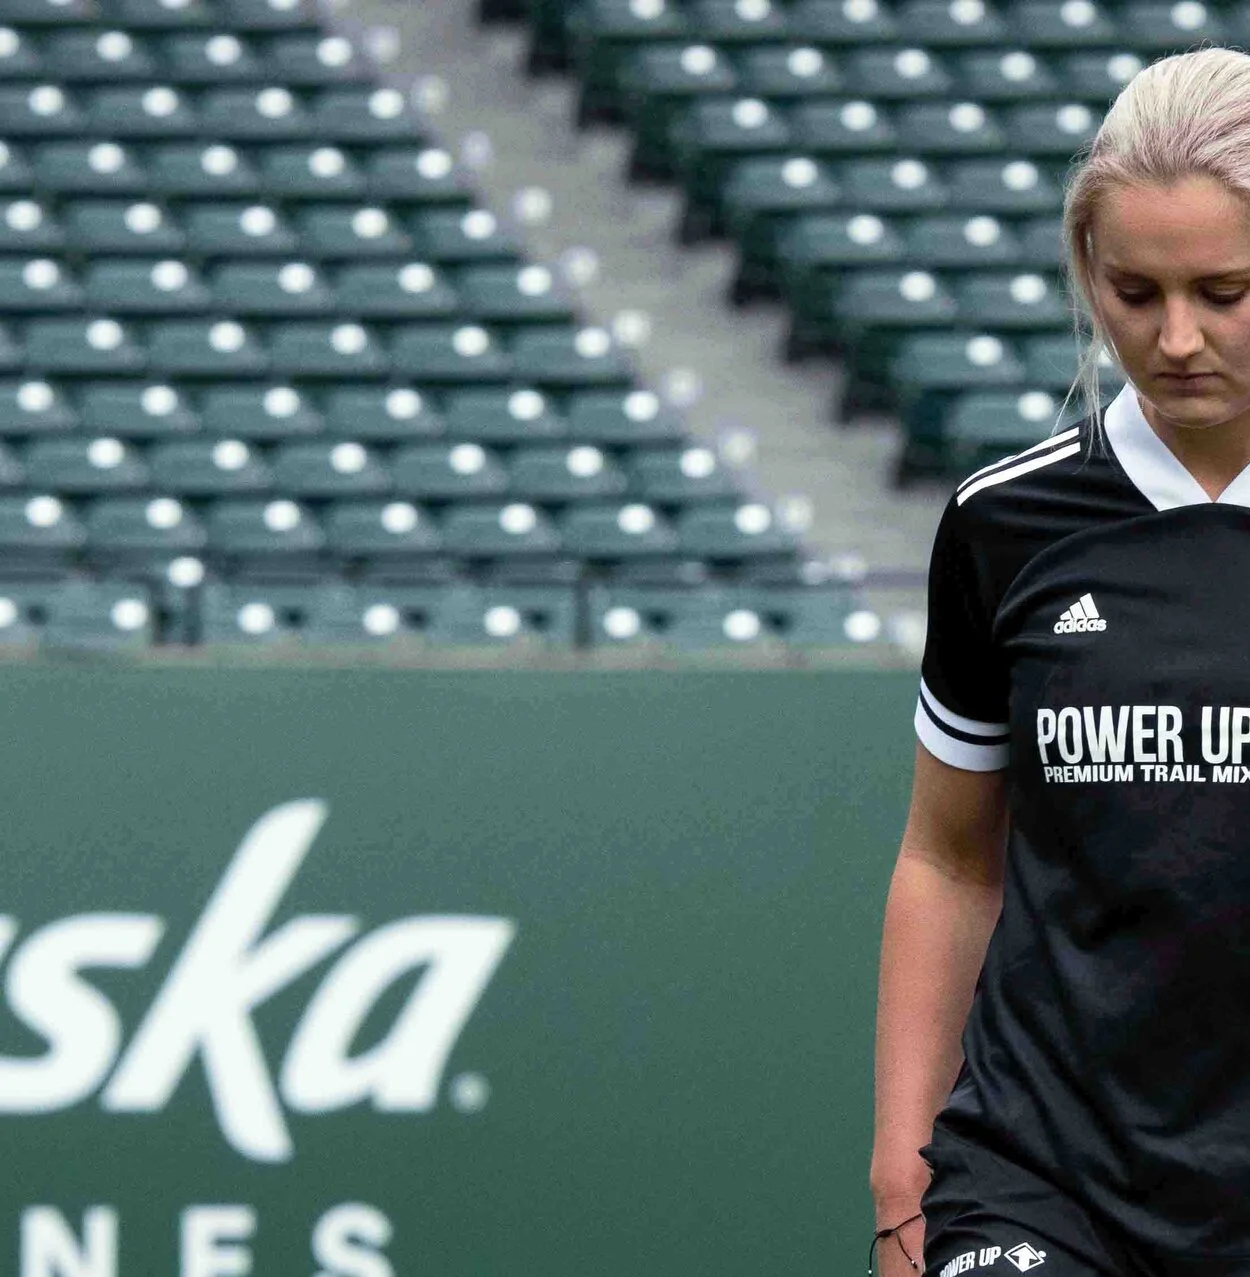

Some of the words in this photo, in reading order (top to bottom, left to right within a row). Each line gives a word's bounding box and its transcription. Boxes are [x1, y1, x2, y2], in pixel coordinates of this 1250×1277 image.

[1053, 617, 1107, 635] adidas
[1036, 705, 1184, 765] POWER
[1044, 765, 1134, 784] PREMIUM
[1140, 765, 1207, 783] TRAIL
[0, 797, 518, 1164] ska
[978, 1246, 1002, 1267] UP
